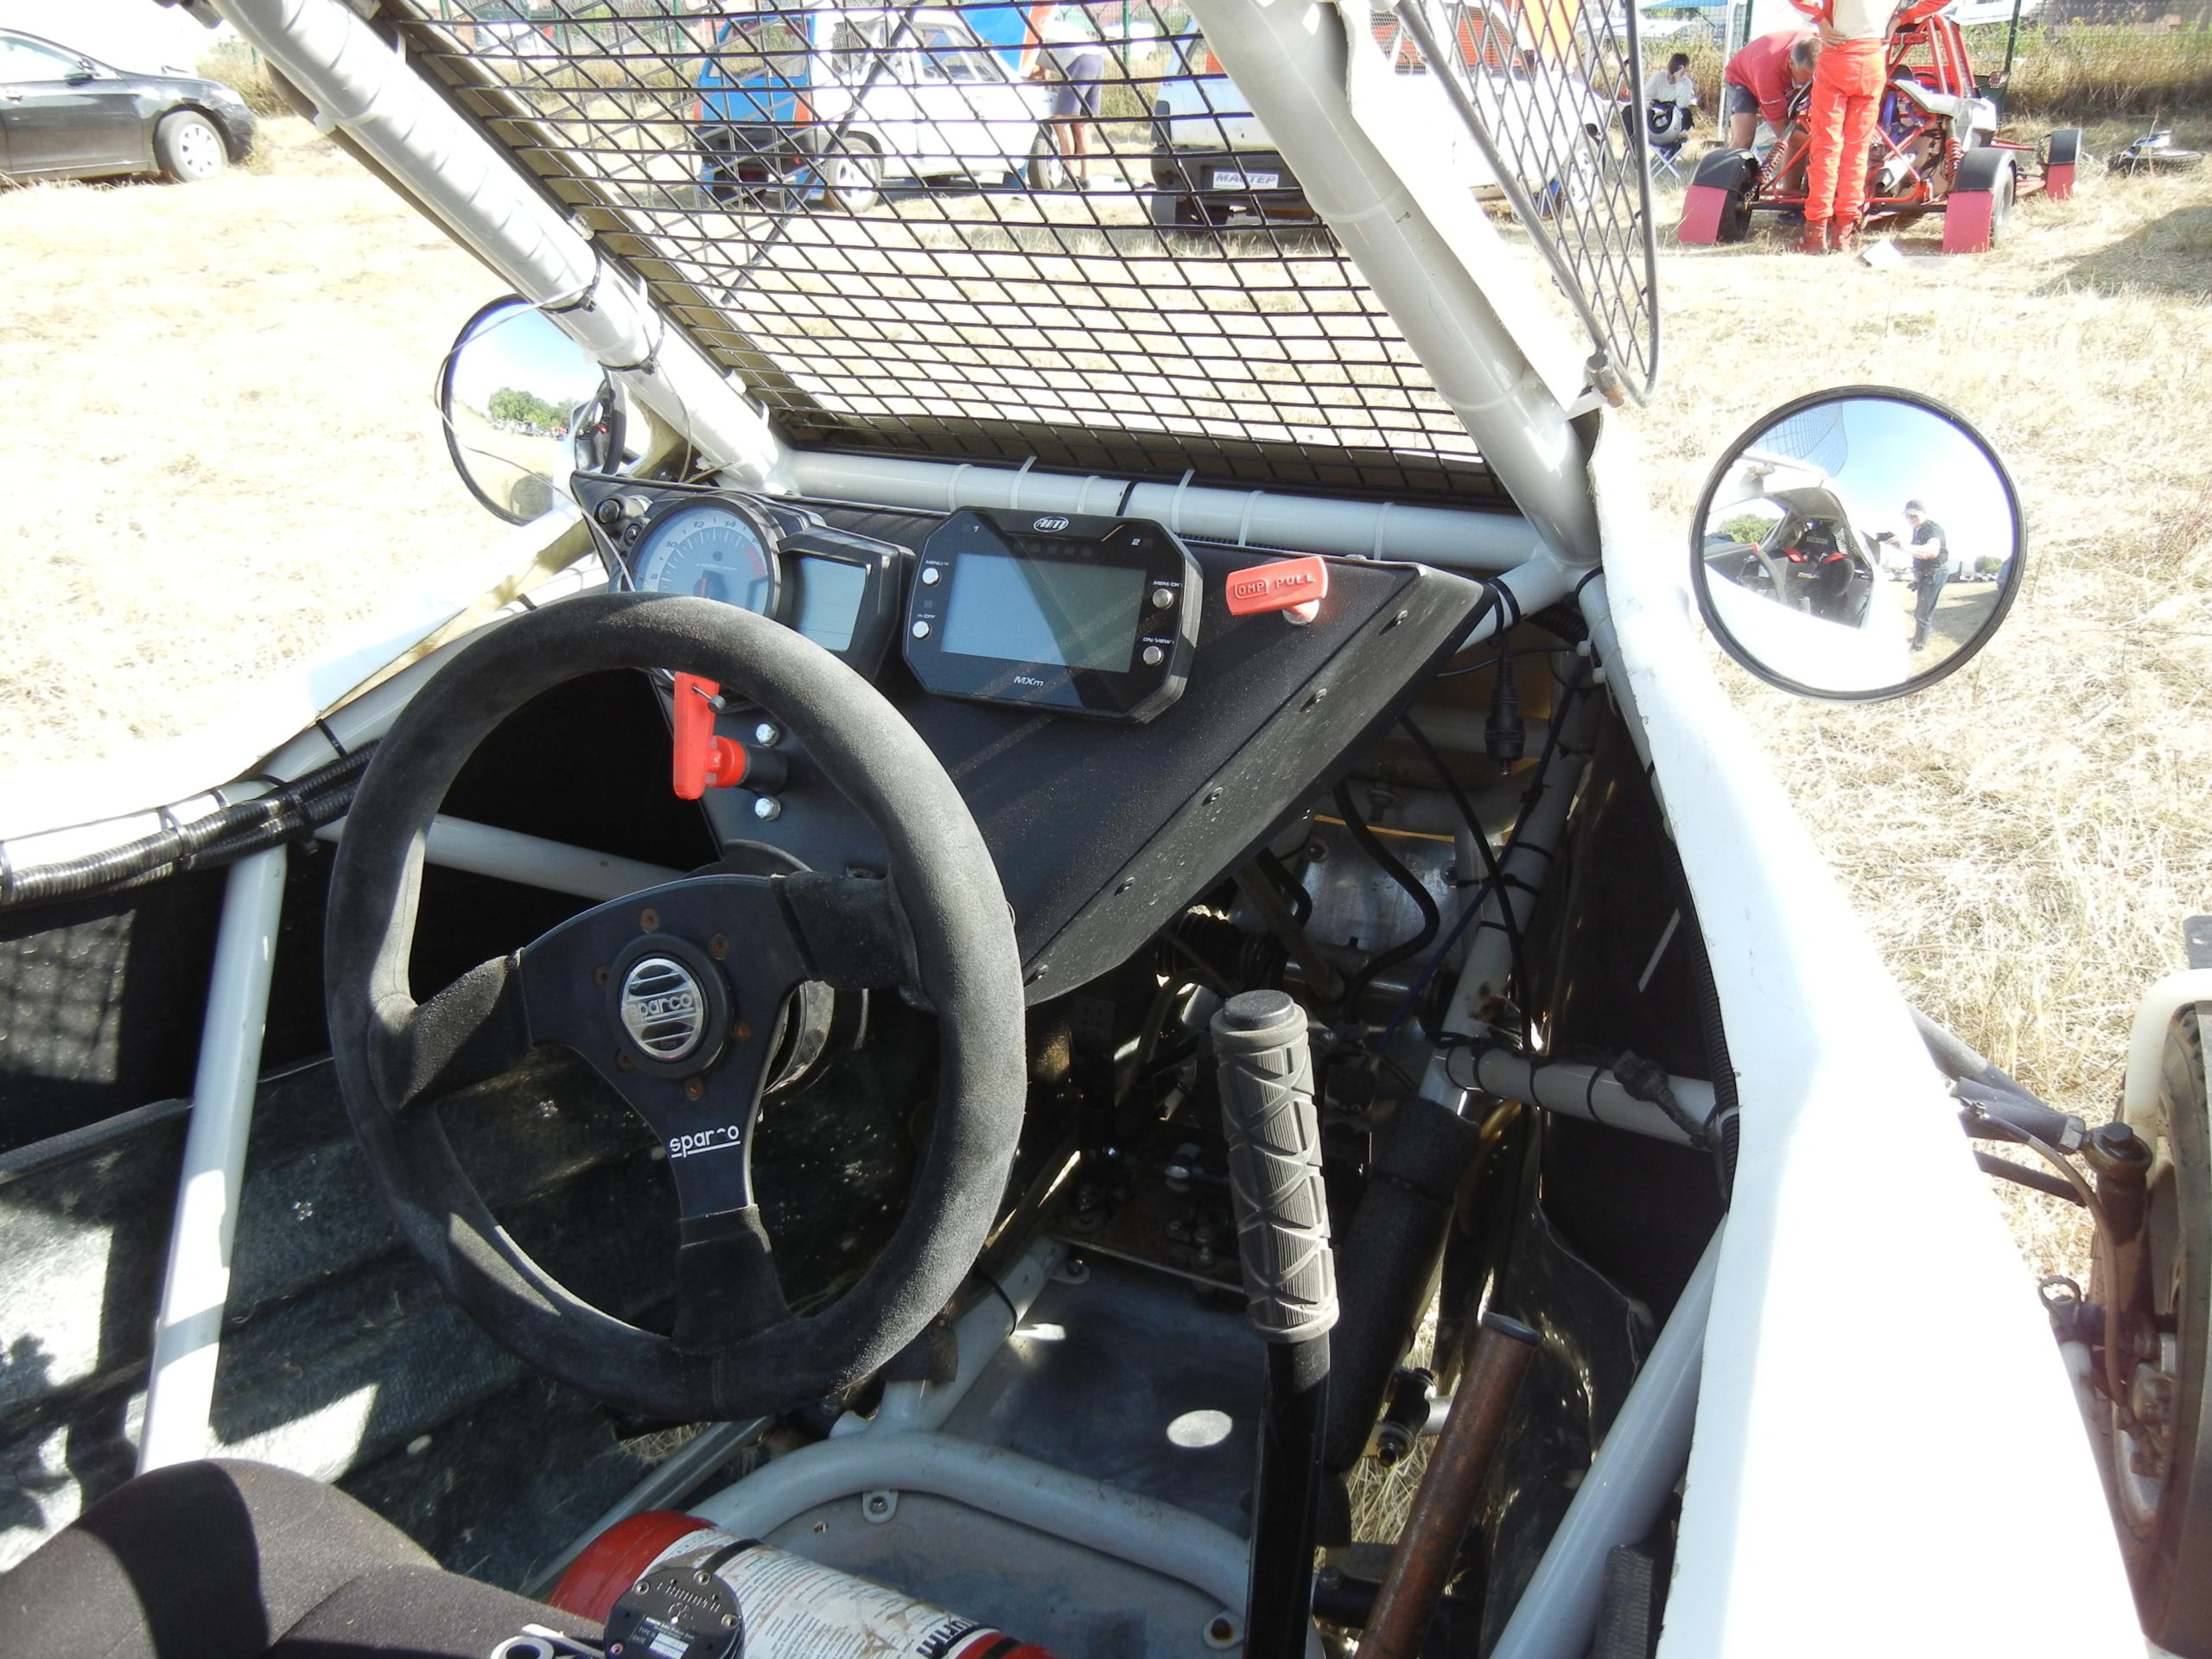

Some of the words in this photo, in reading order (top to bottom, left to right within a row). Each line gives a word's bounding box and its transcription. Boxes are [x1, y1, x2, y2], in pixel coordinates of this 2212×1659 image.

[1237, 582, 1265, 595] OMP
[1275, 573, 1317, 588] PULL
[1014, 676, 1045, 687] MXm
[628, 993, 693, 1021] parco
